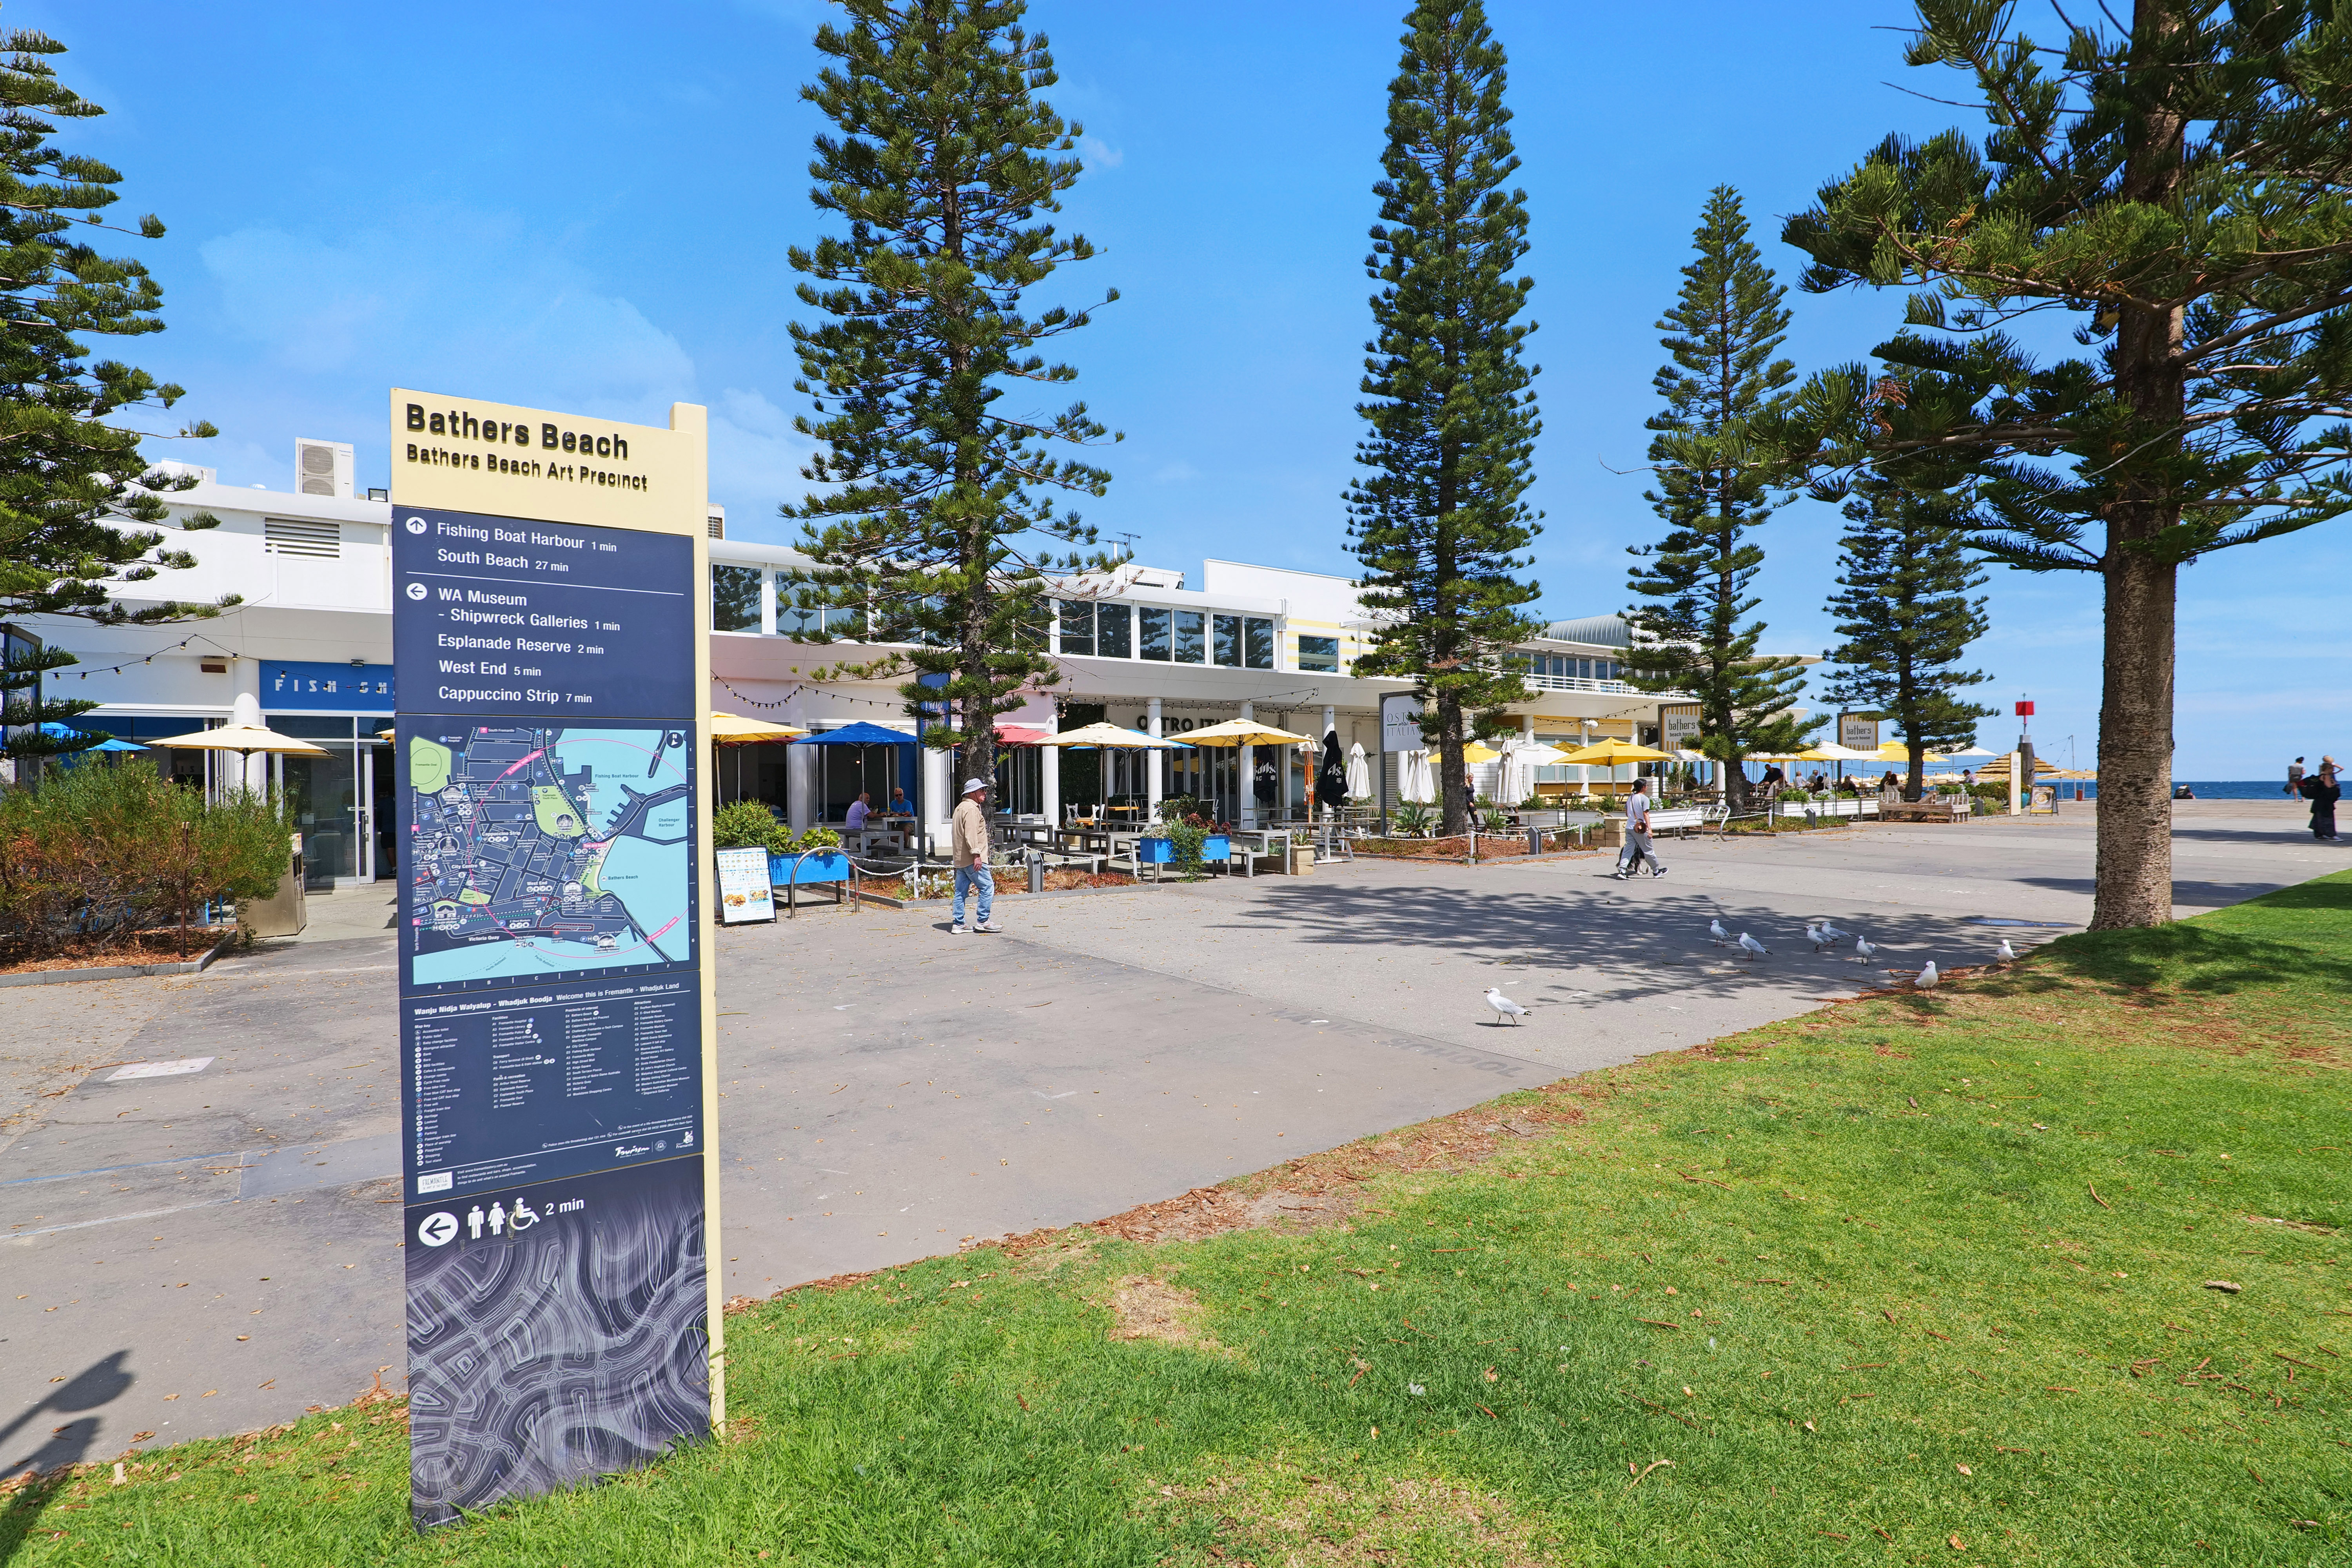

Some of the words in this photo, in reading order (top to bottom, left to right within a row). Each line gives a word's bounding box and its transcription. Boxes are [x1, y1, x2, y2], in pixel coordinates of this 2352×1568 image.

[406, 403, 530, 445] Bathers
[541, 422, 628, 460] Beach
[407, 443, 479, 468] Bathers
[487, 453, 540, 476] Beach
[548, 462, 573, 482] Art
[580, 466, 648, 491] Precinct
[437, 523, 489, 542] Fishing
[494, 528, 526, 543] Boat
[532, 533, 584, 549] Harbour
[592, 542, 596, 550] 1
[600, 542, 617, 552] min
[438, 549, 479, 564] South
[486, 553, 528, 568] Beach
[535, 561, 548, 570] 27
[551, 561, 569, 572] min
[439, 588, 463, 601] WA
[468, 590, 527, 606] Museum
[451, 608, 524, 625] Shipwreck
[530, 614, 588, 629] Galleries
[595, 621, 599, 630] 1
[603, 621, 620, 631] min
[438, 634, 511, 650] Esplanade
[517, 638, 571, 653] Reserve
[578, 645, 584, 653] 2
[586, 645, 604, 654] min
[439, 660, 475, 674] West
[481, 661, 506, 675] End
[514, 667, 520, 675] 5
[523, 666, 541, 676] min
[275, 679, 336, 693] FISH
[439, 686, 521, 703] Cappuccino
[526, 689, 559, 704] Strip
[566, 694, 572, 702] 7
[574, 693, 592, 703] min
[1137, 715, 1194, 731] OTRO
[1387, 711, 1420, 723] OSTO
[1669, 719, 1695, 731] bathers
[1846, 725, 1871, 735] bathers
[459, 1002, 491, 1011] Walyalup
[499, 998, 528, 1007] Whadjuk
[640, 984, 664, 993] Whadjuk
[615, 1145, 650, 1156] Tourism
[423, 1175, 448, 1186] FREMANTLE
[546, 1203, 554, 1216] 2
[560, 1198, 584, 1213] min
